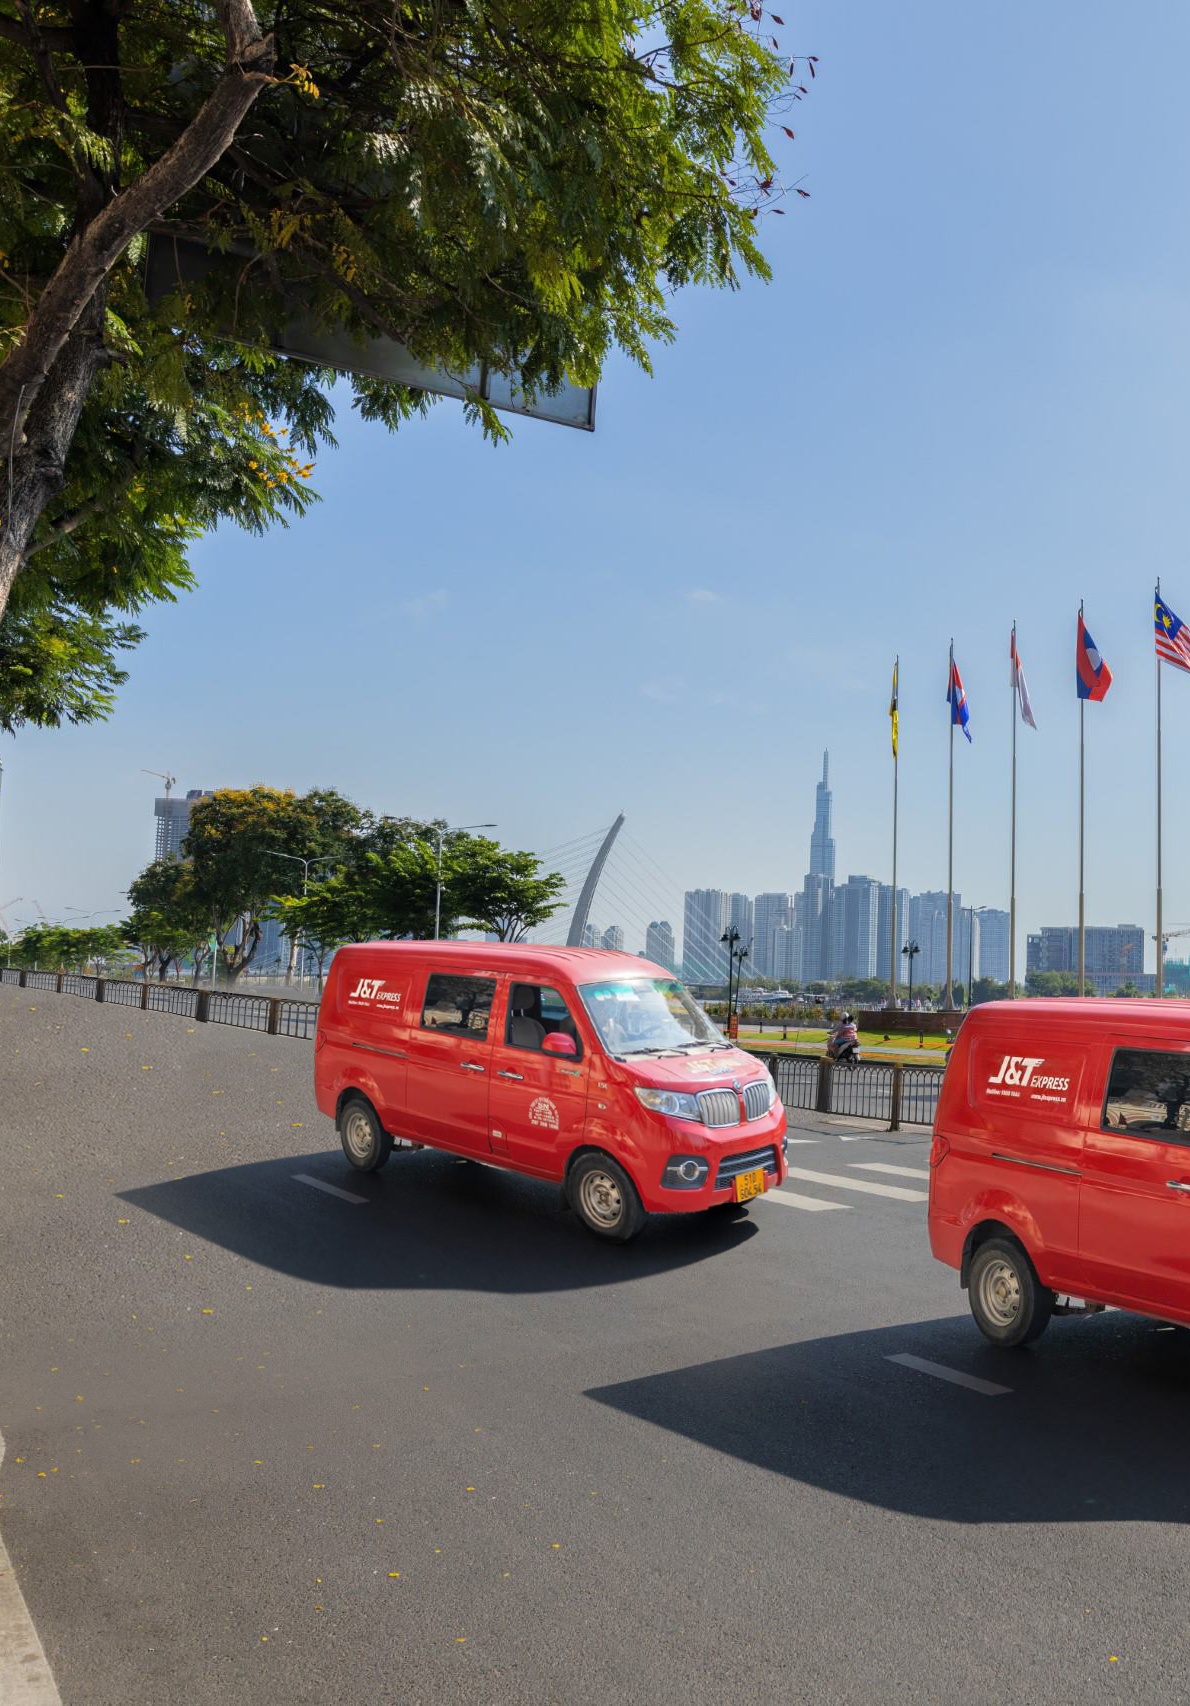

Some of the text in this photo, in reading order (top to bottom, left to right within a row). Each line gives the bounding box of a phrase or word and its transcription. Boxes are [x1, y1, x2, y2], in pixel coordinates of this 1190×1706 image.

[350, 978, 401, 1002] J&T EXPRESS
[988, 1055, 1070, 1091] J&T EXPRESS
